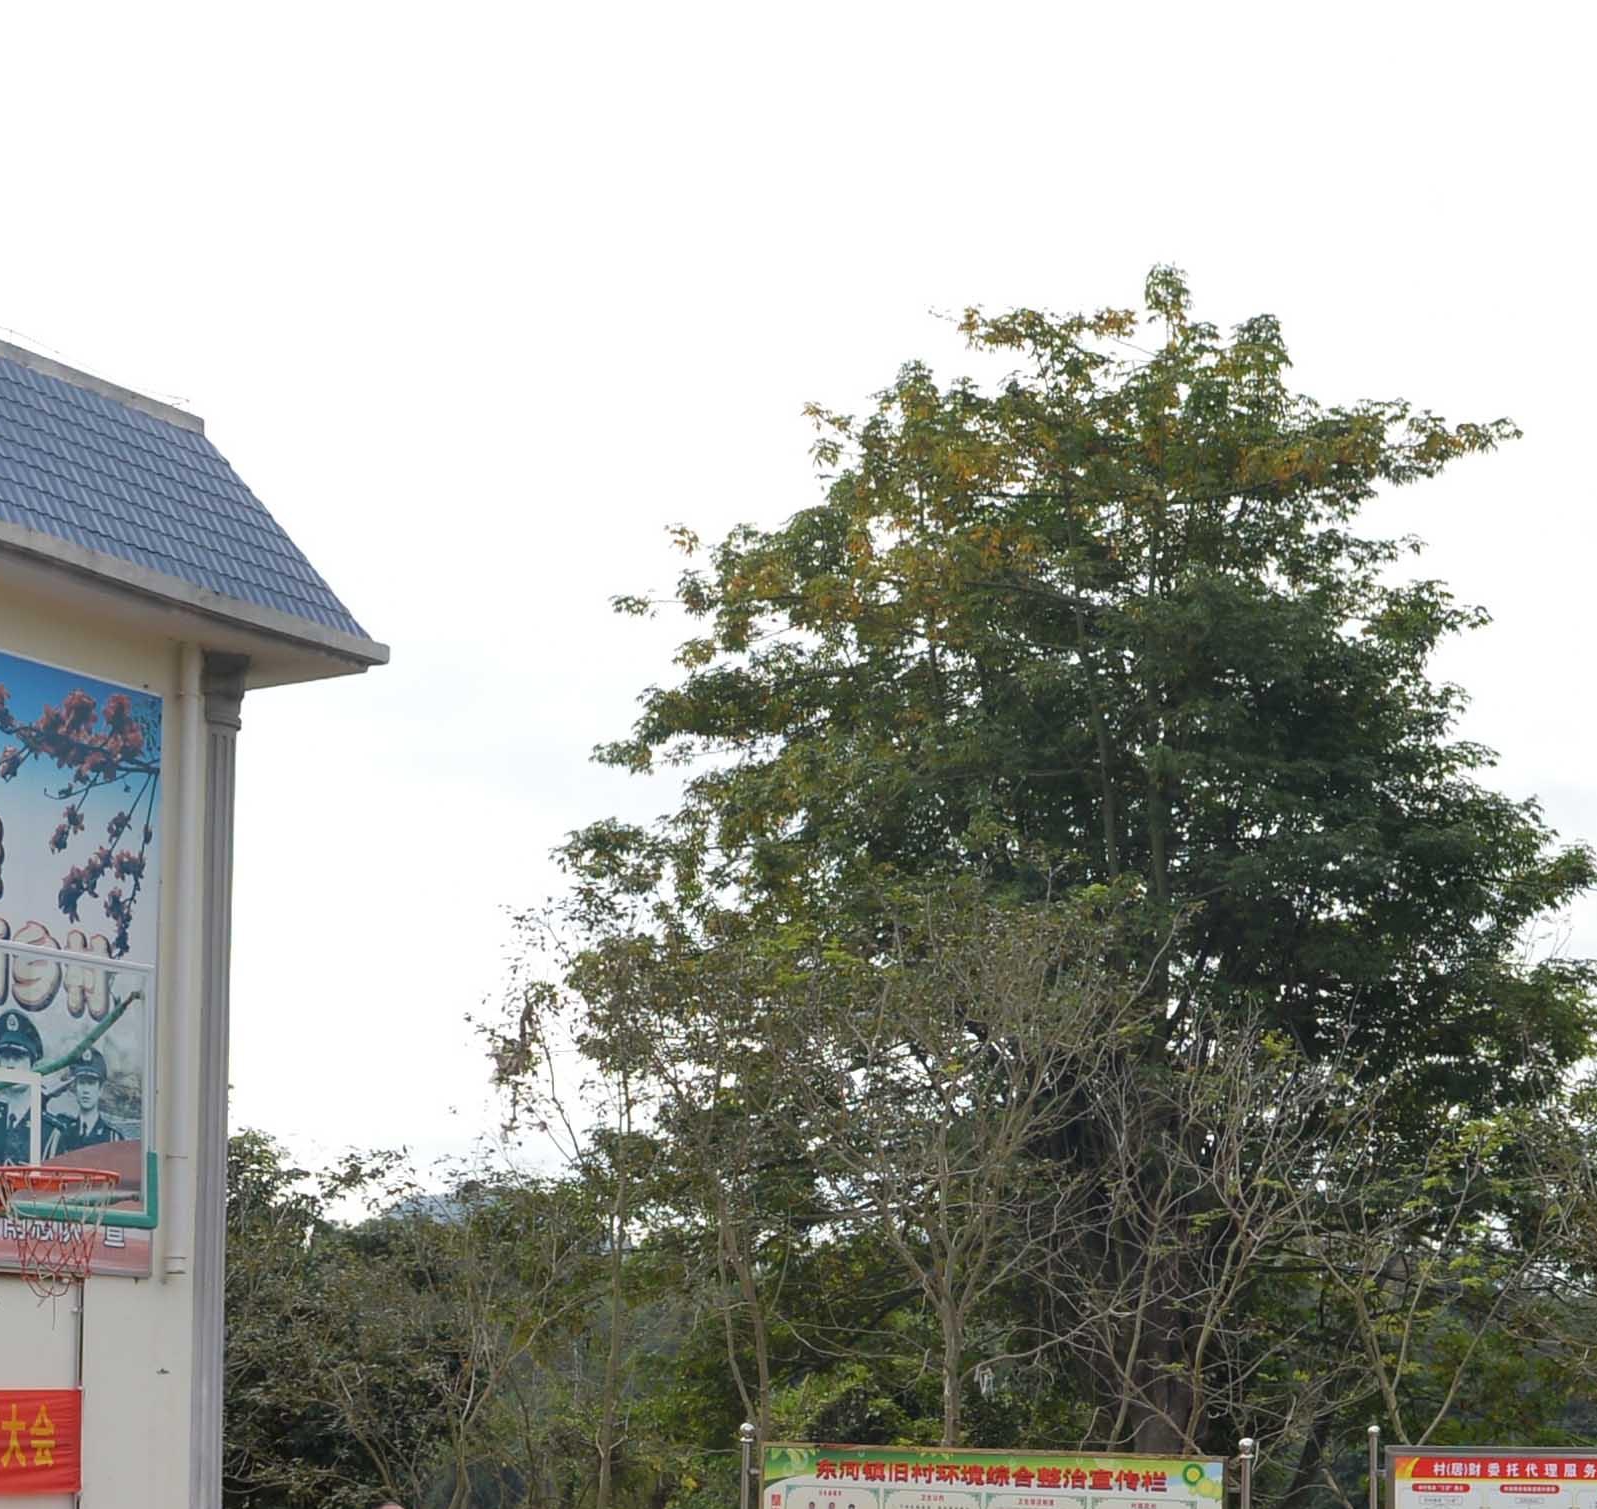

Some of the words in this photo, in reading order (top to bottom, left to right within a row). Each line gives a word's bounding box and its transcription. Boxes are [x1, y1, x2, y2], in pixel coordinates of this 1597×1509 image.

[815, 1458, 1169, 1494] 东河镇旧村环境综合整治宣传栏
